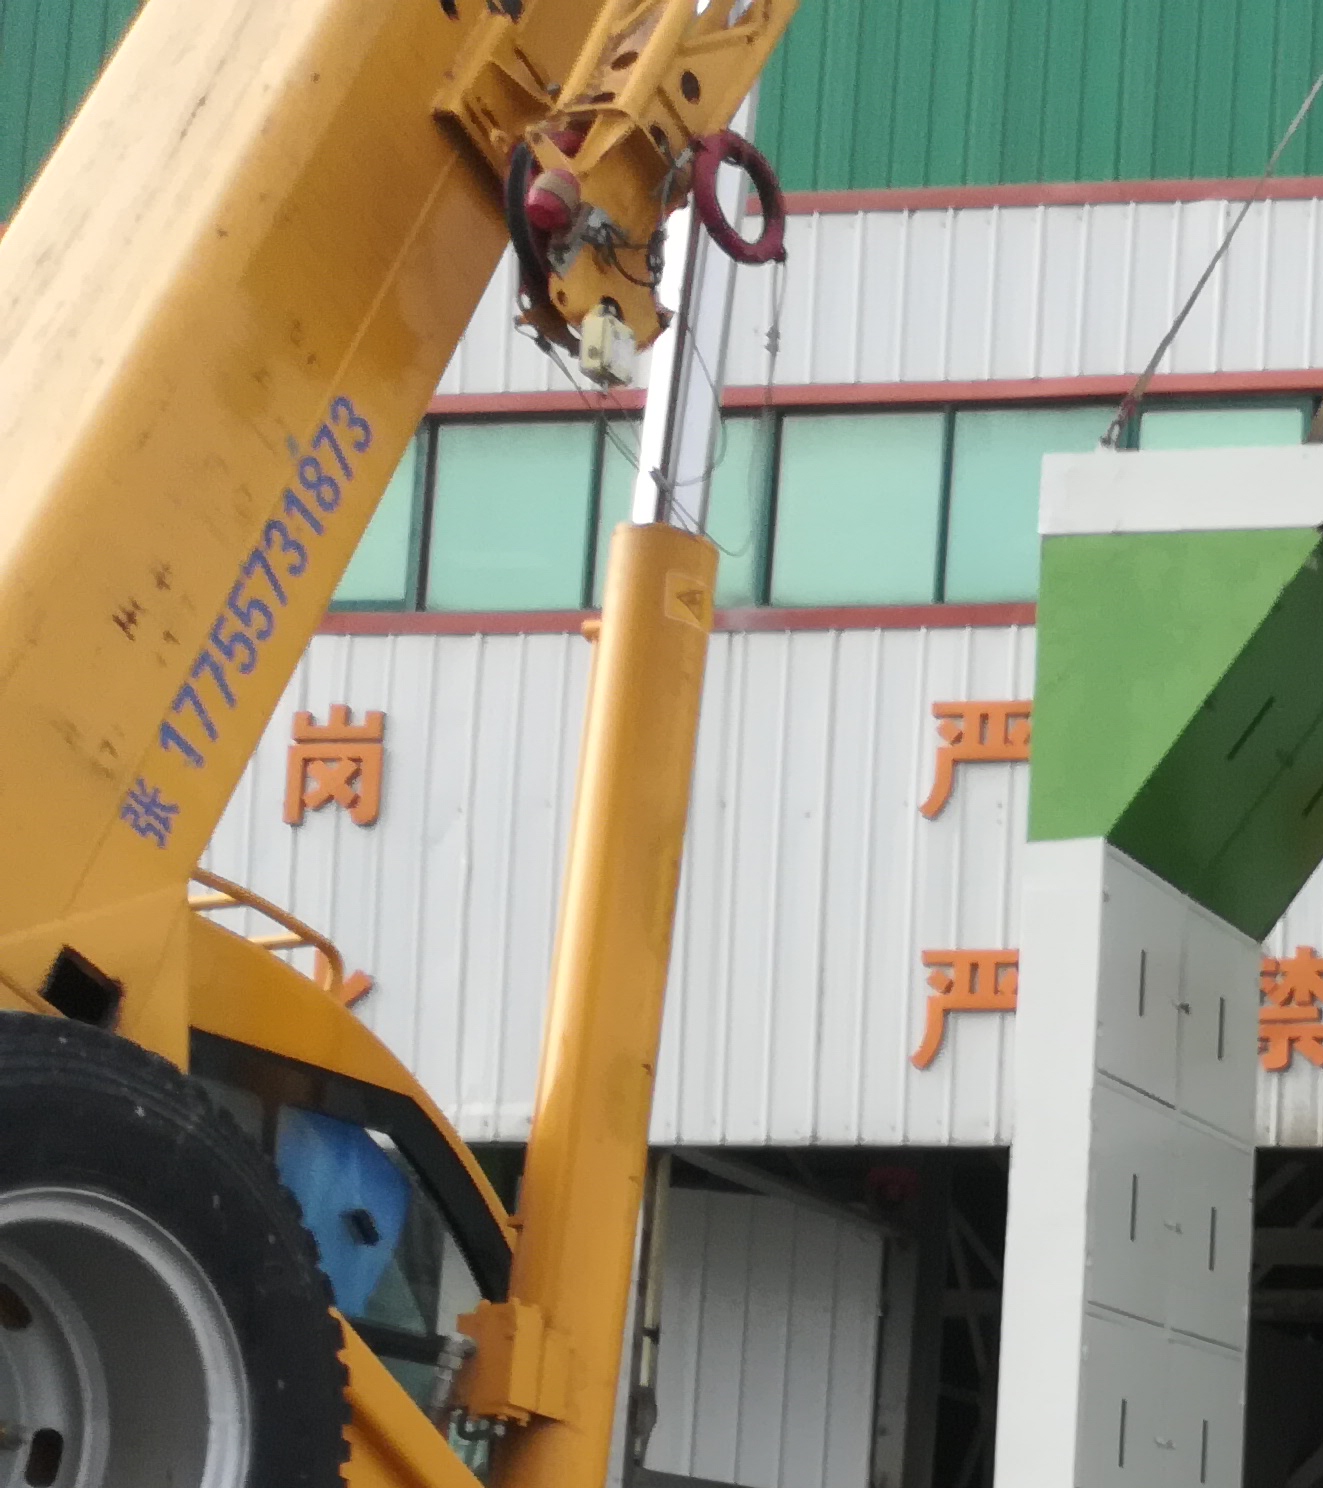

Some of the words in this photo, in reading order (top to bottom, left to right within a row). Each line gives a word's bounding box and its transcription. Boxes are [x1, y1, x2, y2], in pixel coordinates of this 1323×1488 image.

[119, 777, 180, 848] 张
[159, 396, 373, 769] 17755731873
[282, 702, 386, 827] 岗
